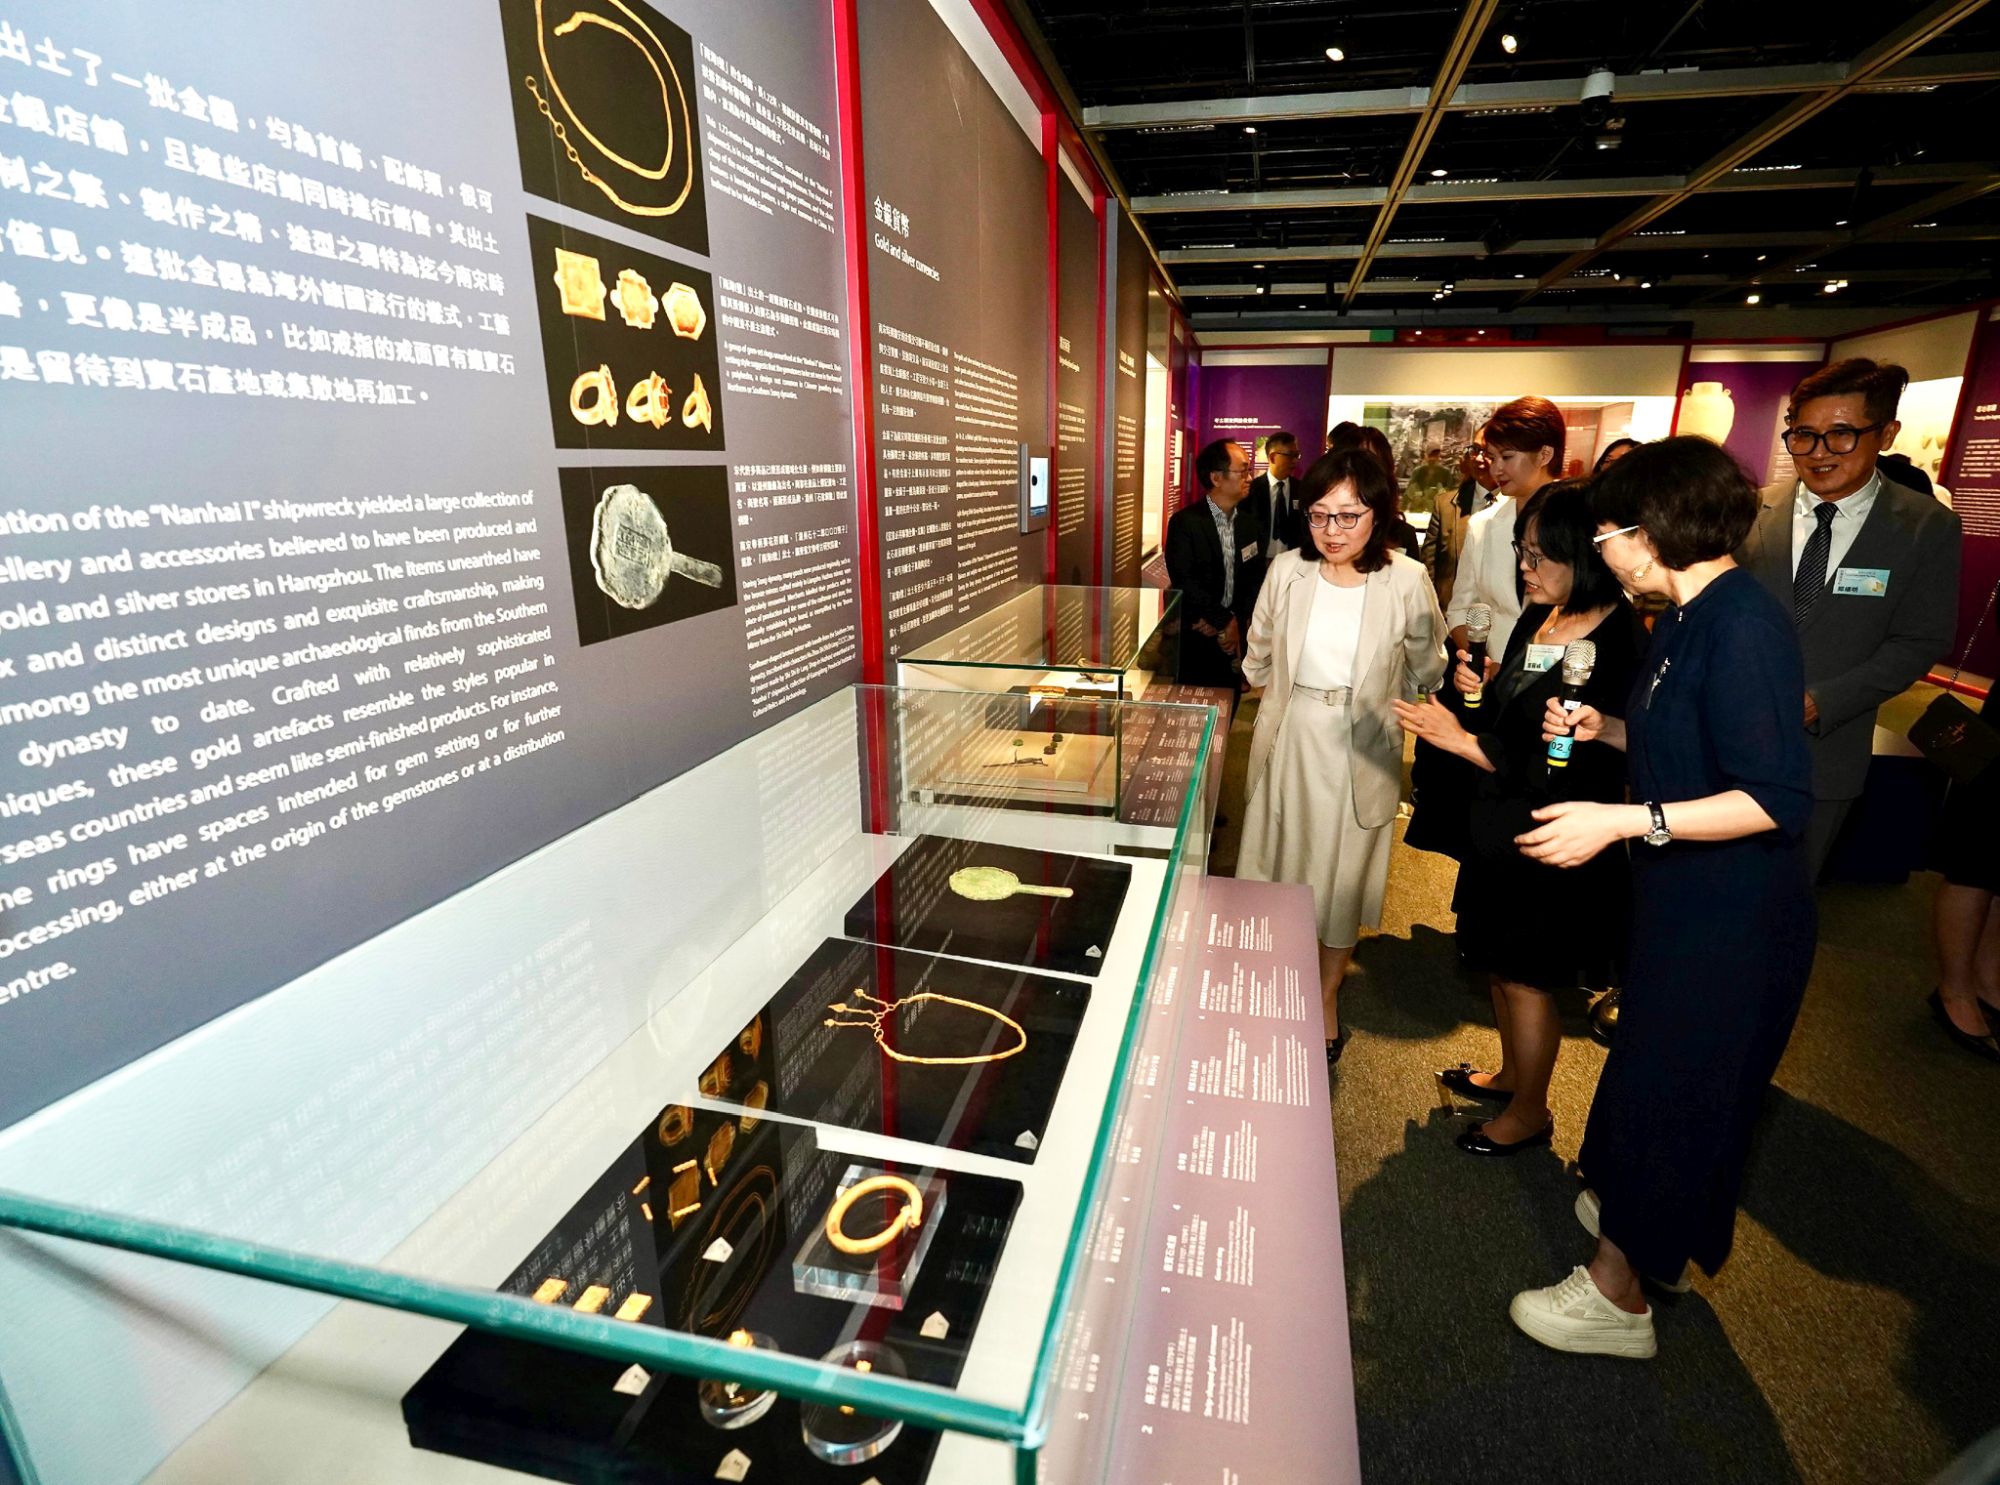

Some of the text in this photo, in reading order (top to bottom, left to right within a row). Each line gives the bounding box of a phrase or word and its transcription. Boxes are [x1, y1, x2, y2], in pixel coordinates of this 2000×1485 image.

[875, 233, 889, 254] Gold
[890, 245, 901, 260] and
[72, 505, 102, 531] of
[103, 504, 150, 529] the
[262, 496, 356, 523] shipwreck
[354, 494, 414, 520] yielded
[414, 497, 426, 512] a
[424, 493, 461, 514] large
[460, 491, 521, 509] collection
[520, 489, 534, 506] of
[80, 547, 134, 576] and
[139, 540, 266, 570] accessories
[268, 531, 349, 558] believed
[350, 532, 371, 550] to
[372, 529, 412, 548] have
[412, 526, 451, 544] been
[452, 519, 514, 545] produced
[514, 517, 538, 535] and
[0, 547, 541, 634] old and silver stores in Hangzhou. The items unearthed have
[27, 641, 85, 674] and
[93, 628, 189, 662] distinct
[195, 617, 278, 645] designs
[283, 605, 321, 631] and
[325, 597, 399, 623] exquisite
[402, 581, 499, 610] craftsmanship,
[501, 574, 546, 594] making
[18, 624, 552, 768] dynasty to date. Crafted with relatively sophisticated
[91, 680, 139, 706] the
[141, 666, 204, 696] most
[204, 654, 280, 683] unique
[281, 626, 404, 668] archaeological
[402, 620, 441, 643] finds
[439, 616, 474, 635] from
[472, 610, 497, 628] the
[495, 602, 549, 624] Southern
[69, 793, 189, 842] countries
[189, 773, 234, 806] and
[234, 762, 291, 792] seem
[289, 751, 325, 774] like
[324, 715, 429, 763] semi-finished
[428, 701, 491, 734] products.
[489, 693, 511, 711] For
[509, 680, 560, 705] instance,
[107, 755, 178, 788] these
[190, 733, 242, 770] gold
[252, 713, 335, 749] artefacts
[342, 690, 415, 723] resemble
[420, 682, 446, 702] the
[451, 671, 489, 694] styles
[493, 657, 539, 685] popular
[542, 653, 556, 667] in
[46, 856, 118, 894] rings
[127, 833, 188, 866] have
[197, 805, 270, 843] spaces
[276, 770, 359, 814] intended
[363, 764, 389, 784] for
[394, 751, 429, 777] gem
[433, 733, 481, 759] setting
[483, 725, 499, 741] or
[502, 718, 521, 735] for
[523, 704, 562, 728] further
[128, 867, 199, 906] either
[203, 855, 229, 879] at
[229, 843, 267, 868] the
[270, 820, 327, 852] origin
[328, 806, 349, 830] of
[349, 800, 380, 821] the
[381, 769, 460, 814] gemstones
[460, 763, 476, 779] or
[477, 755, 492, 773] at
[492, 753, 502, 767] a
[502, 729, 566, 763] distribution
[1160, 1286, 1171, 1294] 3
[1141, 1424, 1153, 1435] 2
